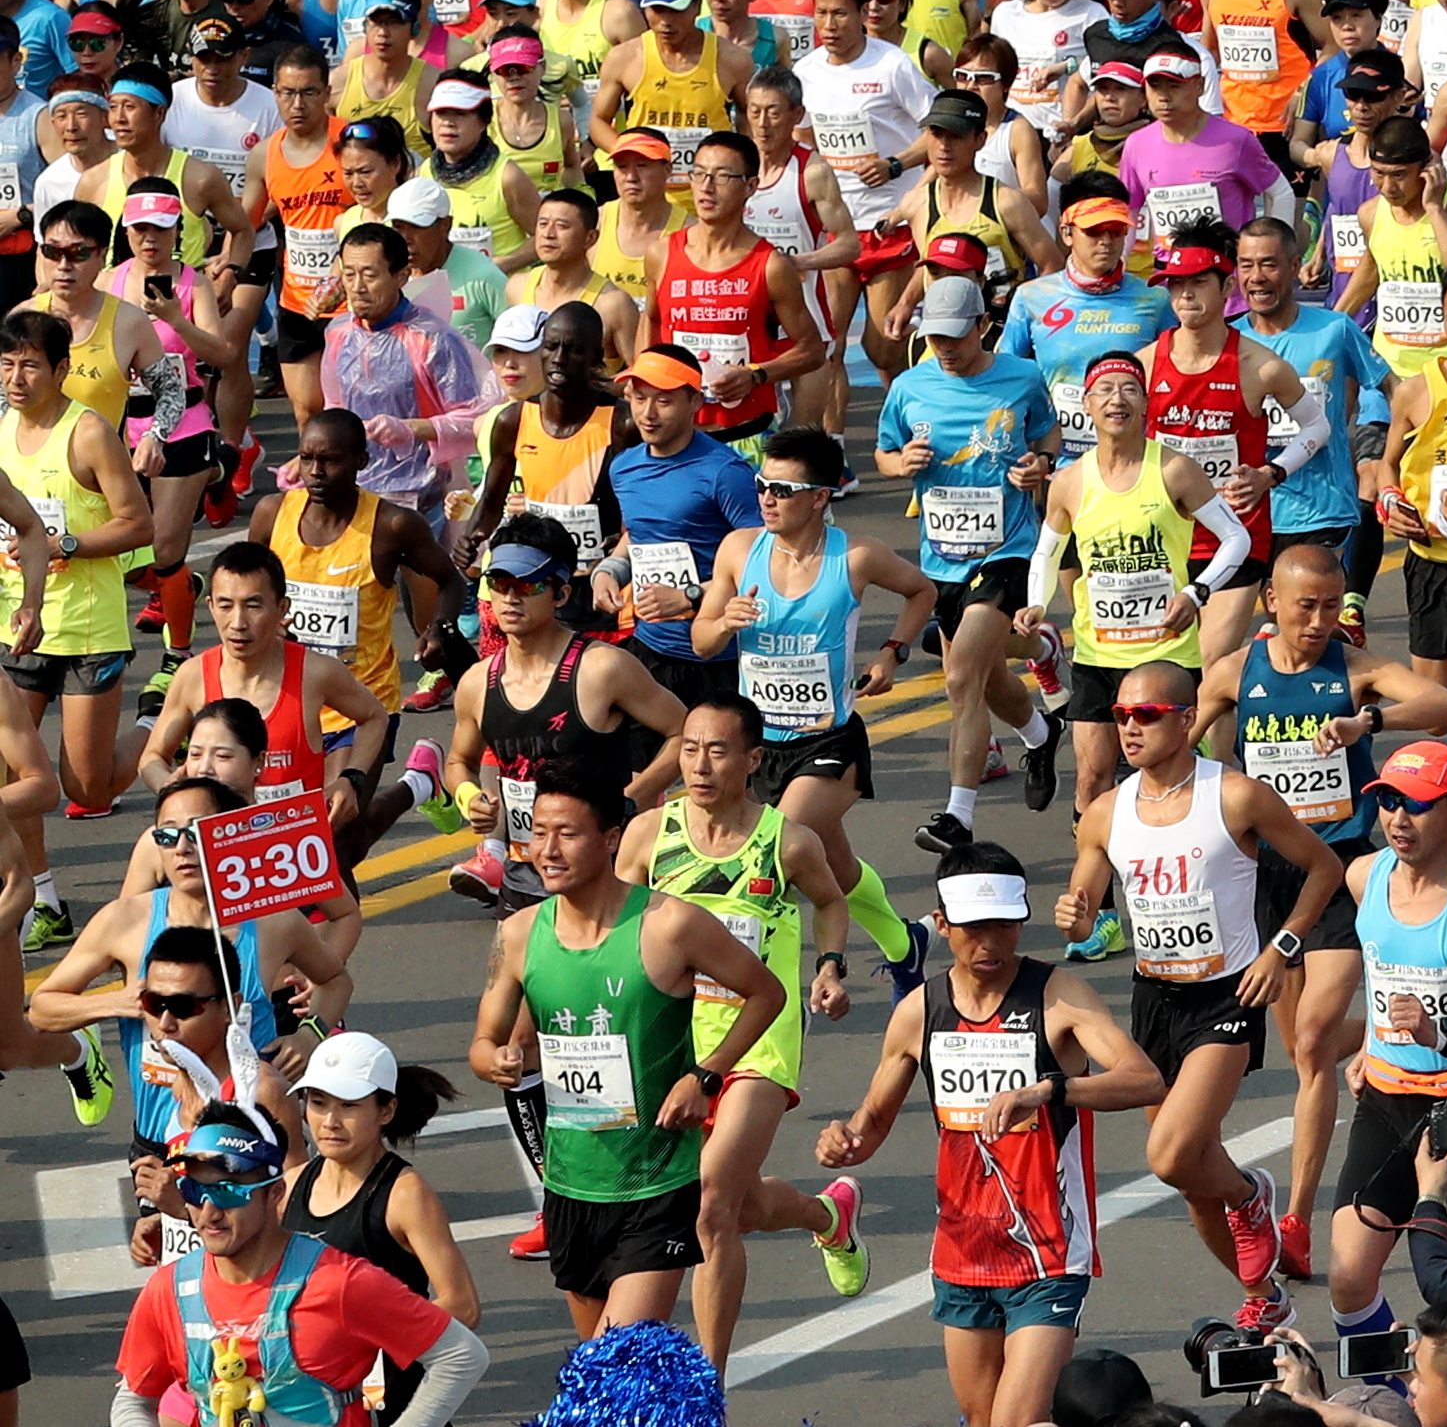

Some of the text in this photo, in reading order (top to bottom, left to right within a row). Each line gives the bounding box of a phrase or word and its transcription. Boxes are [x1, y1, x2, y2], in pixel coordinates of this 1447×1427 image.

[1222, 46, 1272, 65] S0270
[818, 130, 867, 149] S0111
[690, 279, 750, 297] 喜氏金业
[1382, 305, 1445, 324] S0079
[1075, 323, 1140, 335] RUNTIGER
[929, 512, 997, 532] D0214
[1095, 596, 1166, 618] S0274
[295, 613, 350, 634] 0871
[753, 680, 827, 702] A0986
[219, 834, 329, 900] 3:30
[1136, 922, 1213, 949] S0306
[550, 1003, 613, 1034] 甘肃
[558, 1071, 603, 1095] 104
[940, 1067, 1024, 1094] S0170
